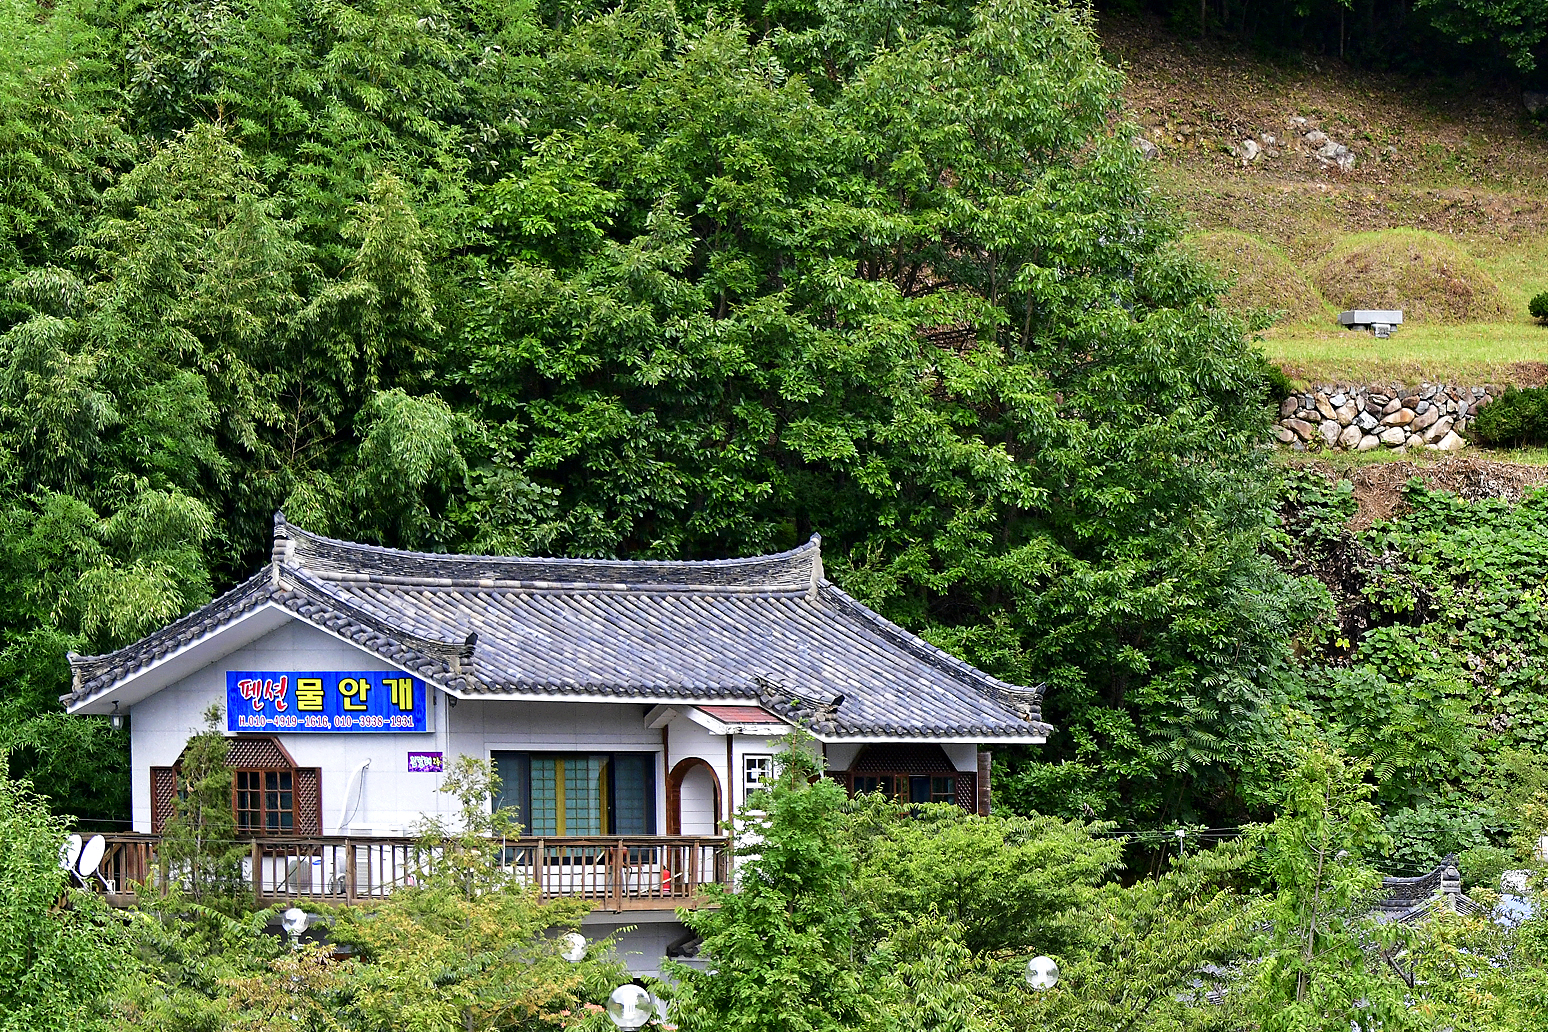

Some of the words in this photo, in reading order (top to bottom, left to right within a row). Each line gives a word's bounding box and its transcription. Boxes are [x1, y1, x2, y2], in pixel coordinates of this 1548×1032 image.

[238, 676, 288, 712] 펜션
[295, 678, 413, 711] 물안개
[334, 715, 414, 728] 010-3938-1931
